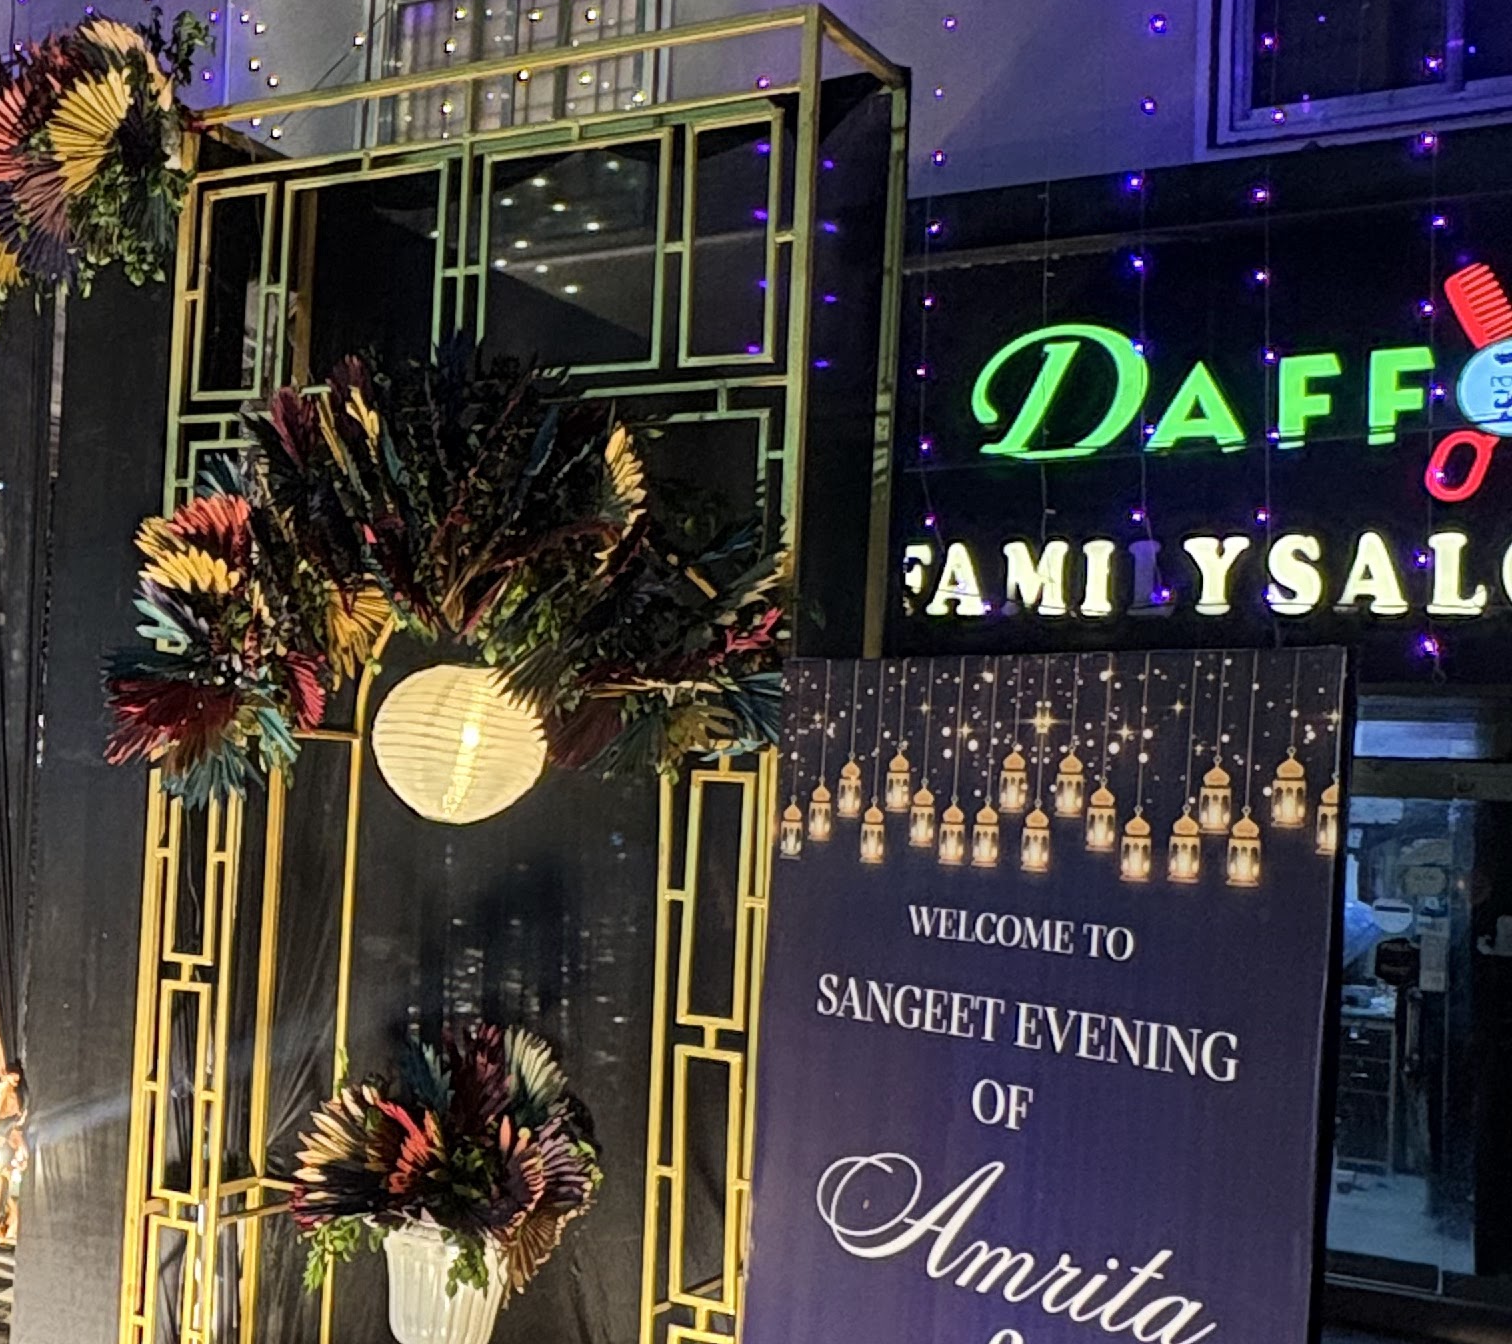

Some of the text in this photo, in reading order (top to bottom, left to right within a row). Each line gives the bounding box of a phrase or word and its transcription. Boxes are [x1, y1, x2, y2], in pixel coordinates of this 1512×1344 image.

[908, 904, 1135, 961] WELCOME TO
[816, 973, 1240, 1083] SANGEET EVENING
[971, 1078, 1034, 1131] OF
